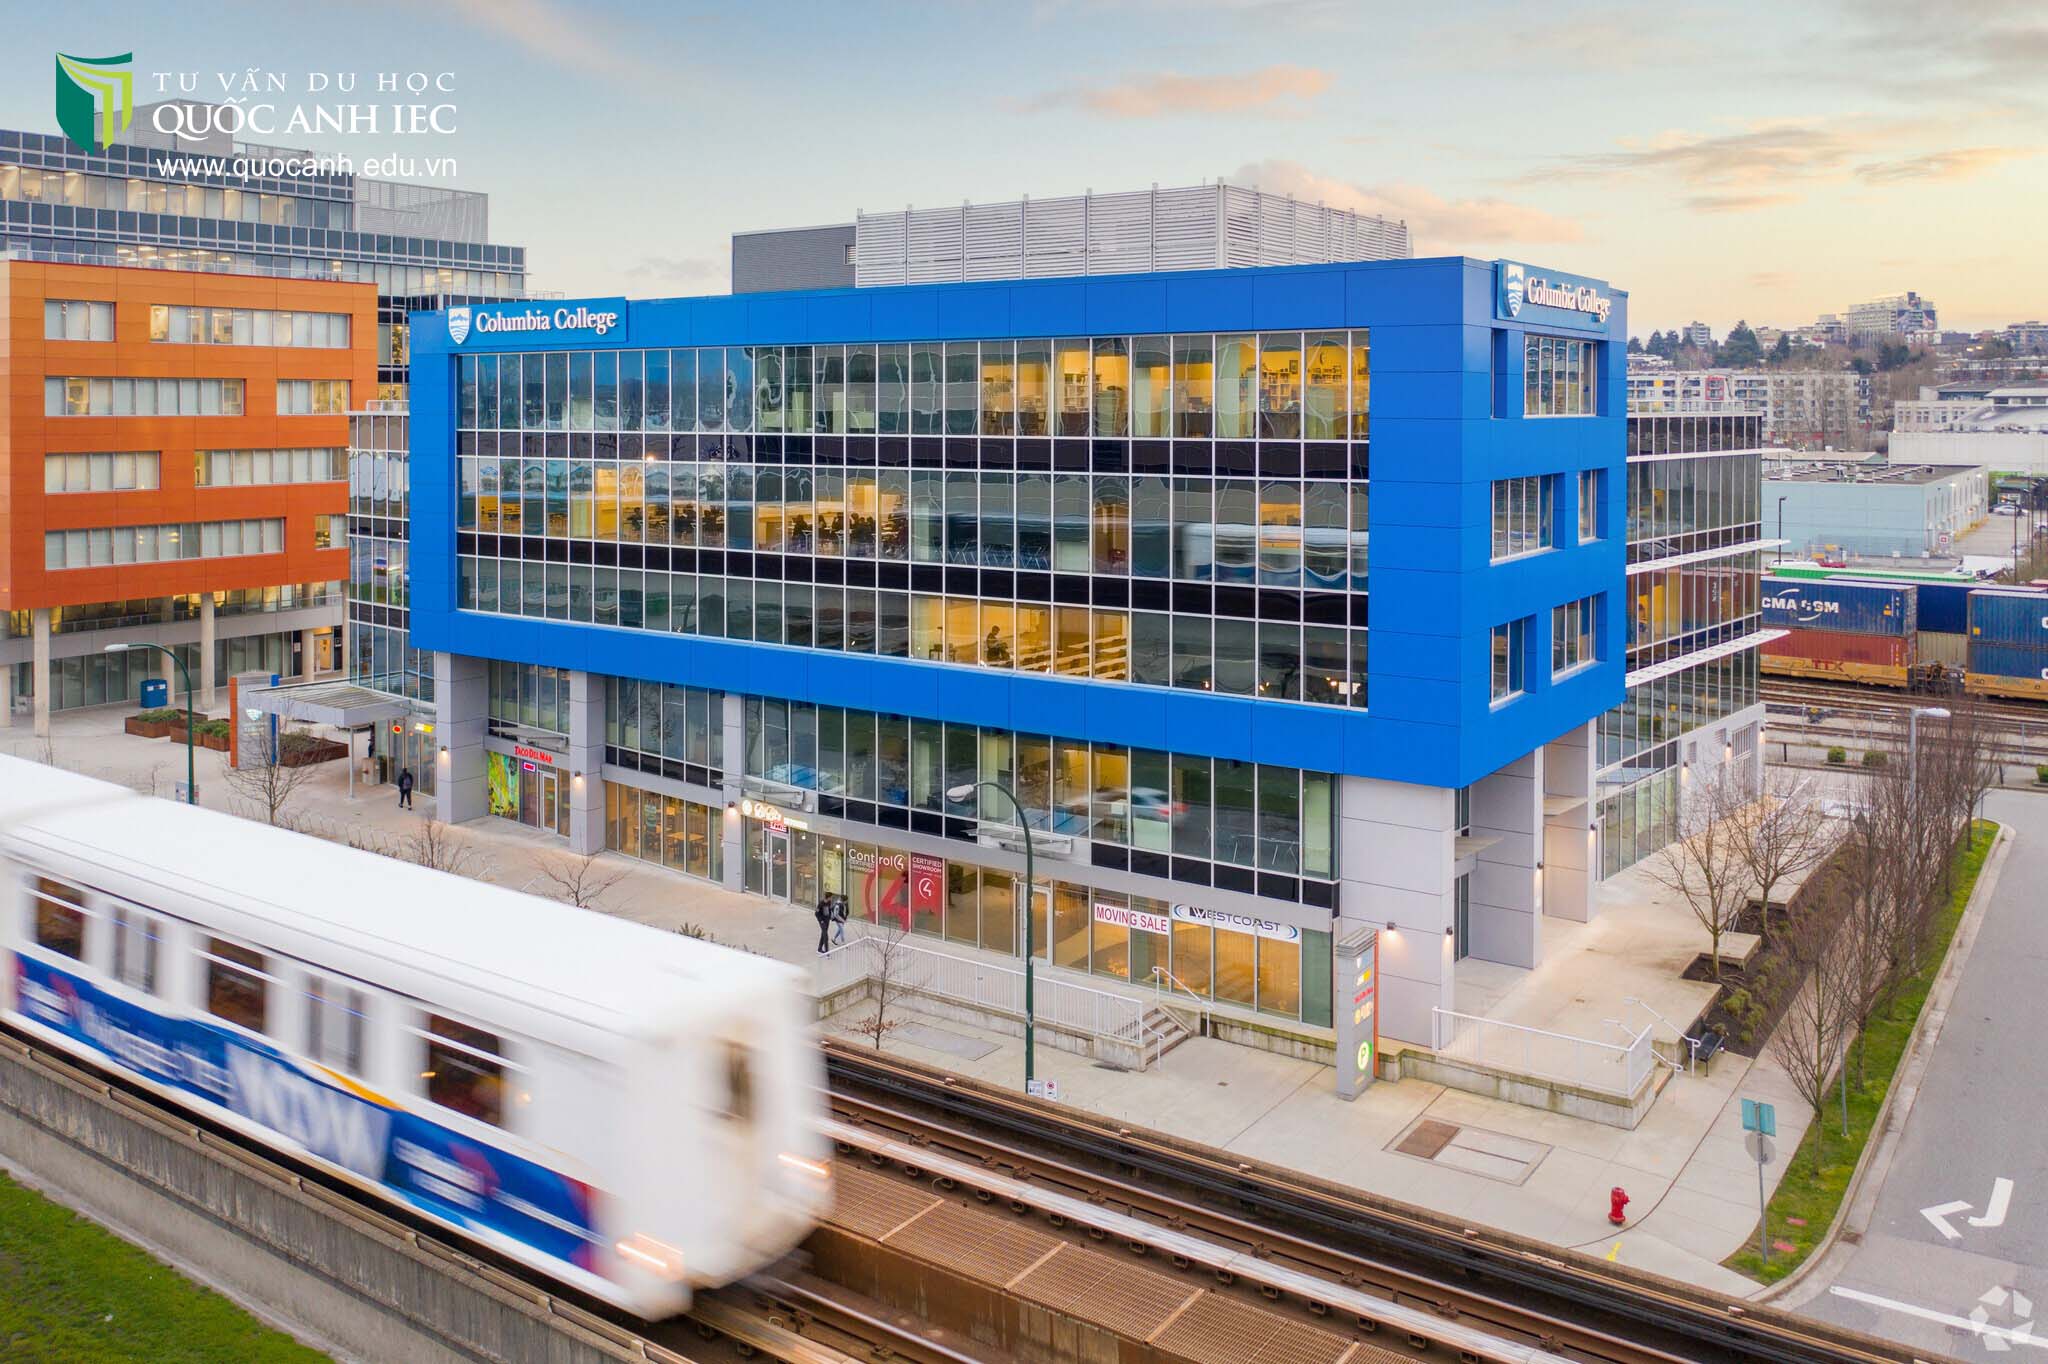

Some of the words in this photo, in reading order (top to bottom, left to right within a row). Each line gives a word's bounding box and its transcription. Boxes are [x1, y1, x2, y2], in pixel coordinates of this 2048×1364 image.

[1527, 276, 1576, 310] Columbia
[1577, 286, 1611, 322] College
[475, 309, 551, 333] Columbia
[553, 307, 617, 335] College
[1761, 596, 1797, 611] CMA
[912, 856, 942, 869] CERTIFIED
[912, 863, 942, 874] SHOWROOM
[1096, 906, 1138, 927] MOVING
[1140, 914, 1168, 933] SALE
[1189, 906, 1281, 932] WESTCOAST
